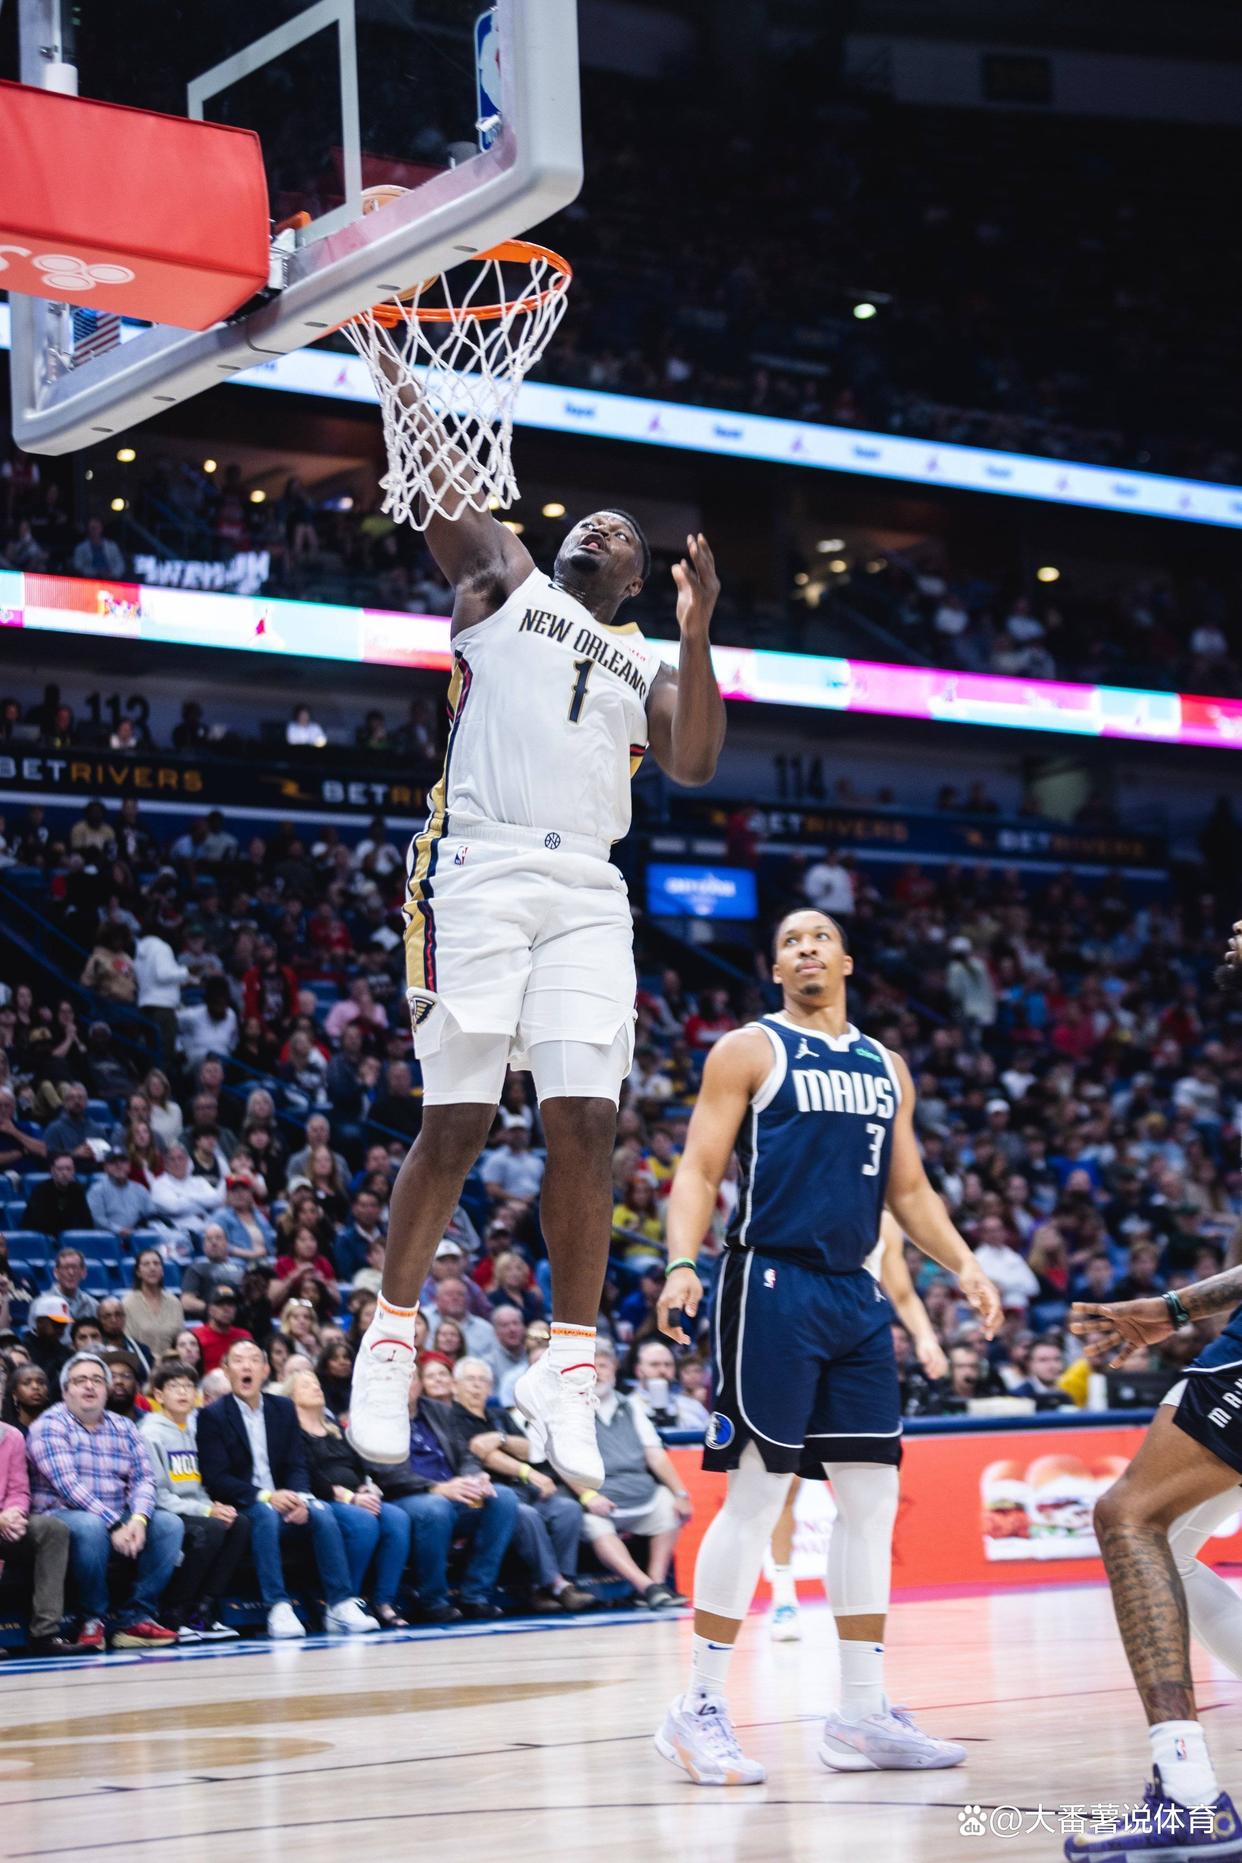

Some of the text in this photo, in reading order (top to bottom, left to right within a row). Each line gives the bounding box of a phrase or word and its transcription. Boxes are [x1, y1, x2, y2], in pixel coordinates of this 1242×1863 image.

[518, 608, 648, 701] NEW ORLEANS
[566, 657, 595, 725] 1
[0, 755, 203, 792] BETRIVERS
[321, 779, 422, 806] BETRI
[861, 1122, 887, 1176] 3
[1207, 1377, 1242, 1429] MA
